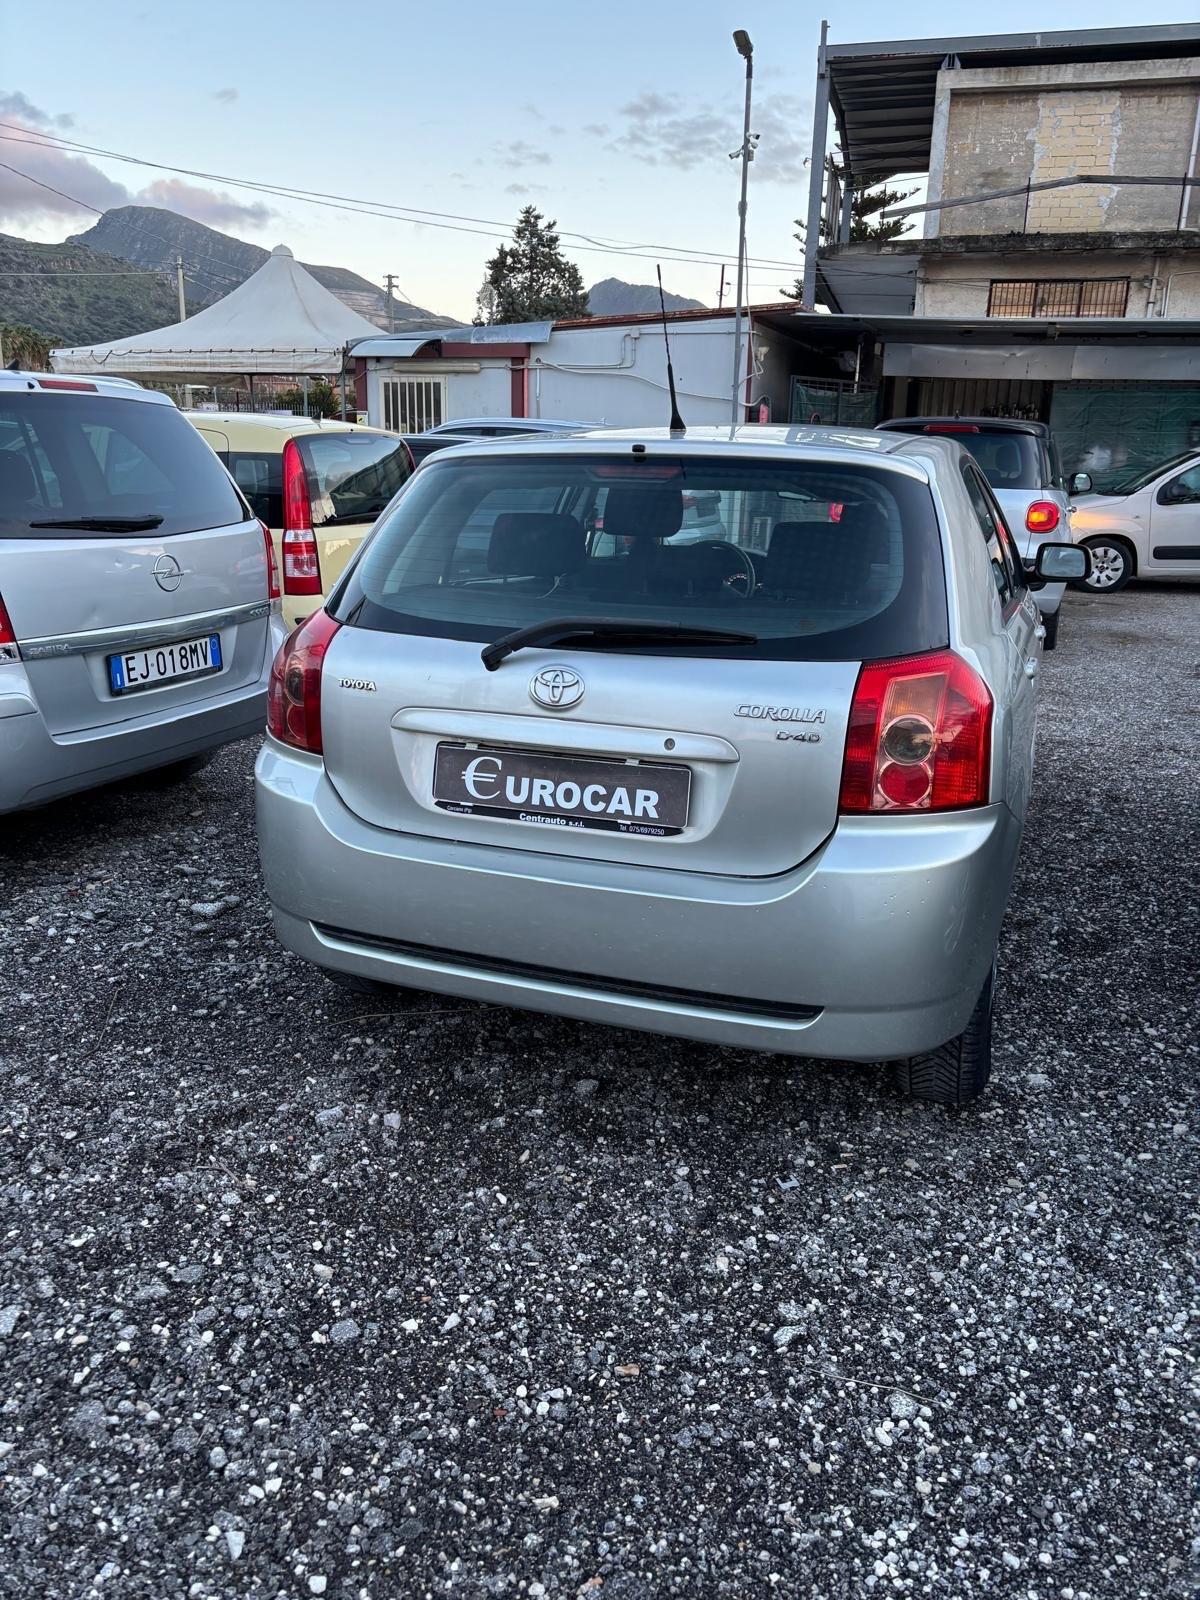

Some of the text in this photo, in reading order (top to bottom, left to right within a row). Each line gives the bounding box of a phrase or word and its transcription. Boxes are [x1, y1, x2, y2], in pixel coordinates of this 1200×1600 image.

[338, 678, 377, 691] TOYOTA
[734, 704, 827, 723] COROLLA
[519, 812, 567, 826] Centrauto
